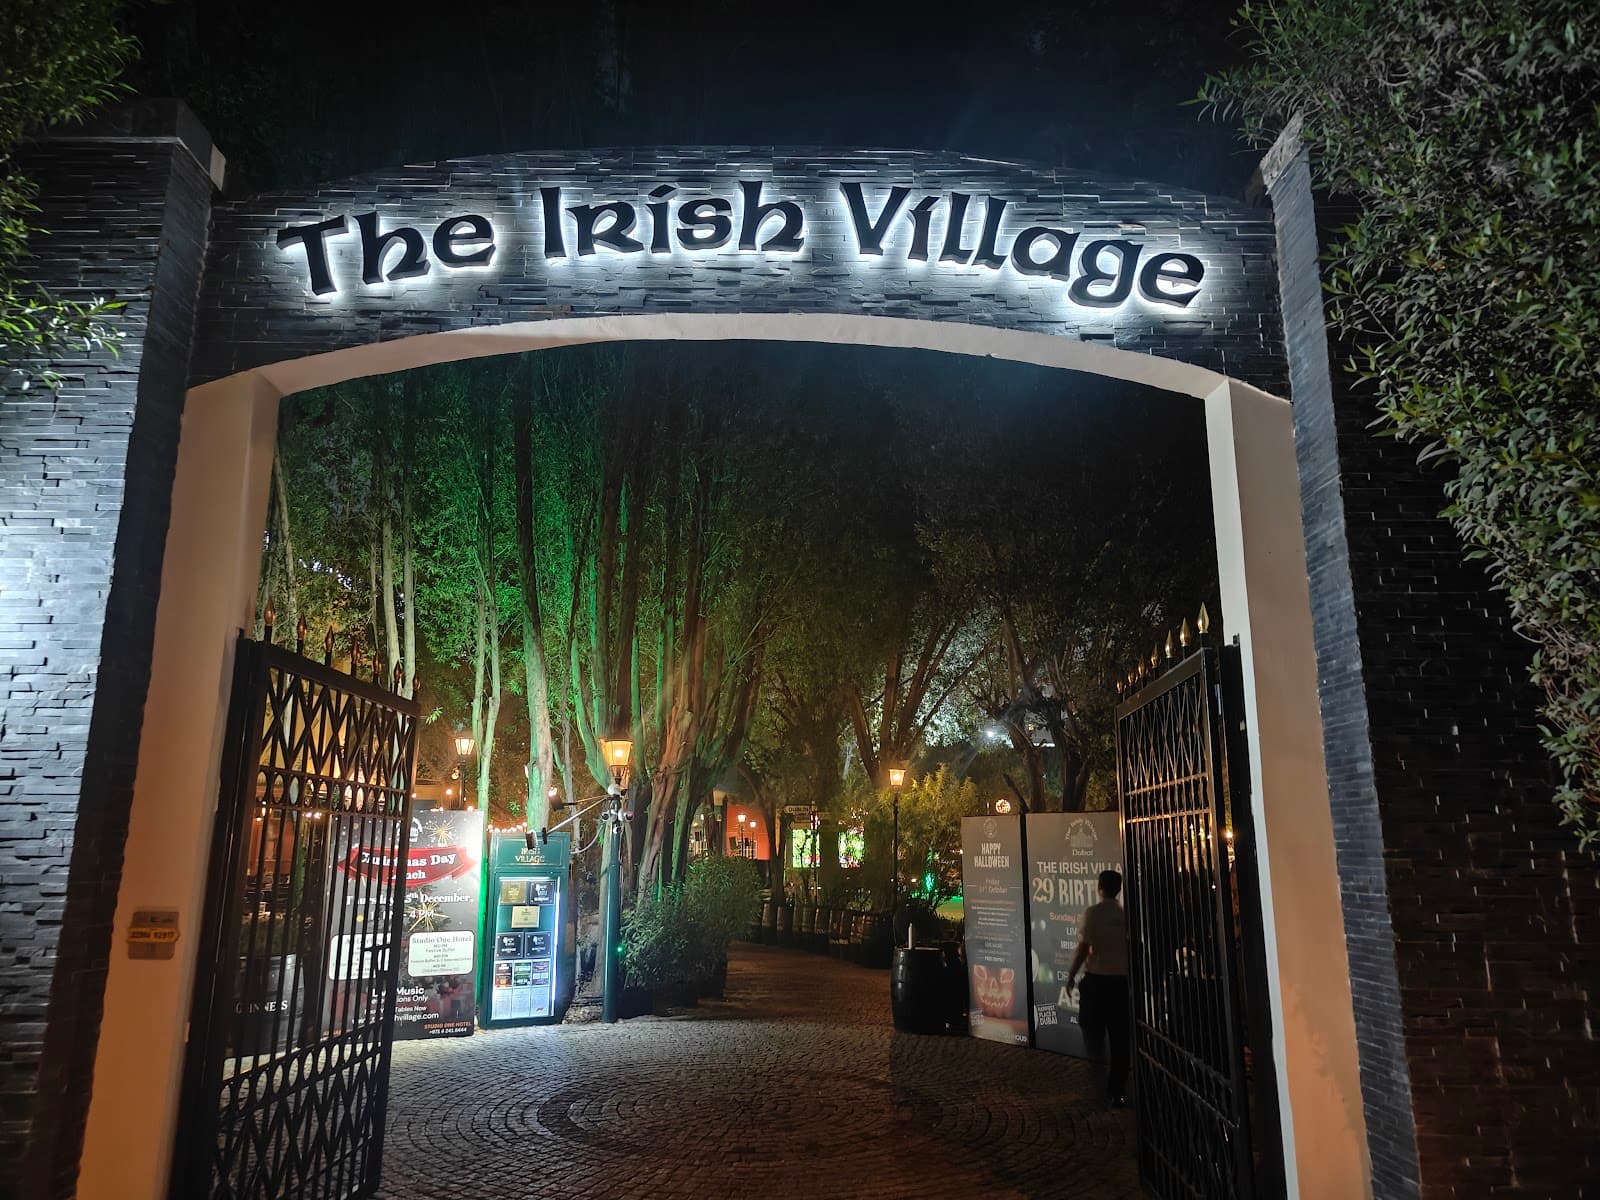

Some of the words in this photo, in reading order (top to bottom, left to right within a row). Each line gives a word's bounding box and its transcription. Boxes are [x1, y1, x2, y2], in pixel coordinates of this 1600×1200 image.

[276, 210, 496, 296] The
[540, 180, 806, 259] Irish
[839, 182, 1206, 309] Village
[981, 842, 1001, 856] HAPPY
[430, 853, 457, 865] Day
[515, 855, 546, 864] VILLAGE
[974, 855, 1010, 869] HALLOWEEN
[1037, 861, 1057, 874] THE
[1059, 861, 1089, 875] IRISH
[1090, 862, 1123, 876] VILLA
[1032, 877, 1055, 905] 29
[420, 893, 475, 904] December.
[409, 909, 416, 918] 4
[418, 908, 435, 918] PM
[1049, 912, 1076, 922] Sunday
[1066, 927, 1077, 935] LIV
[396, 986, 425, 995] Music
[235, 1000, 289, 1014] GINNES
